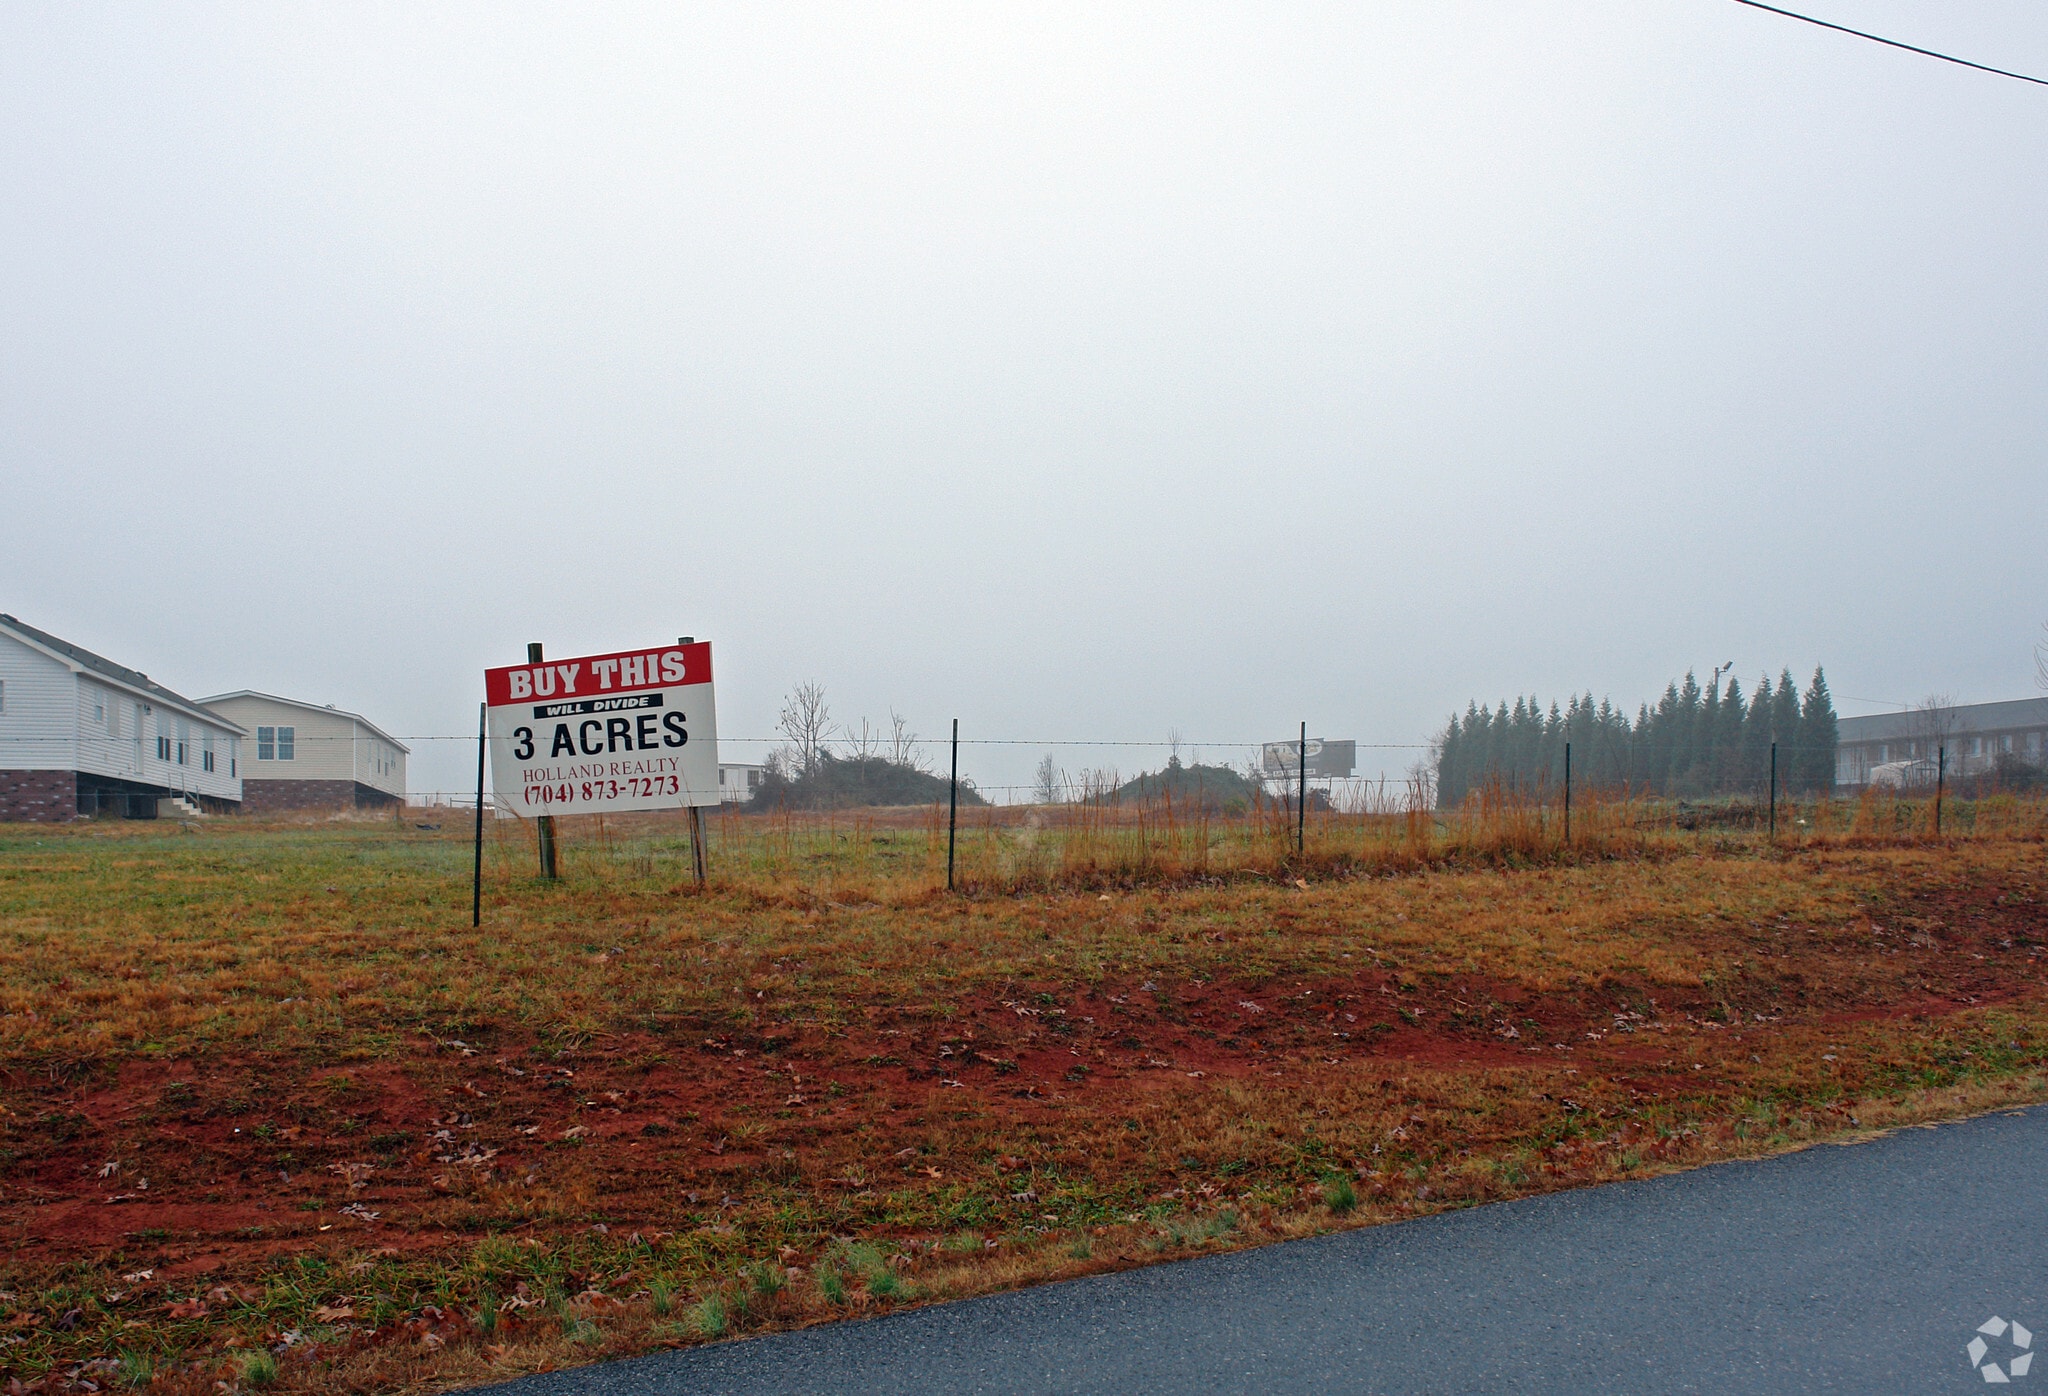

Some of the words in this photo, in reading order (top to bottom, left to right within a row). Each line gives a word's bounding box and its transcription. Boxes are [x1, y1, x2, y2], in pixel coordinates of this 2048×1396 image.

[509, 663, 580, 700] BUY
[592, 651, 686, 689] THIS
[546, 703, 584, 716] WILL
[593, 697, 649, 712] DIVIDE
[514, 727, 534, 760] 3
[551, 712, 688, 758] ACRES
[523, 763, 604, 782] HOLLAND
[610, 757, 679, 775] REALTY
[524, 784, 574, 805] (704)
[582, 775, 679, 801] 873-7273
